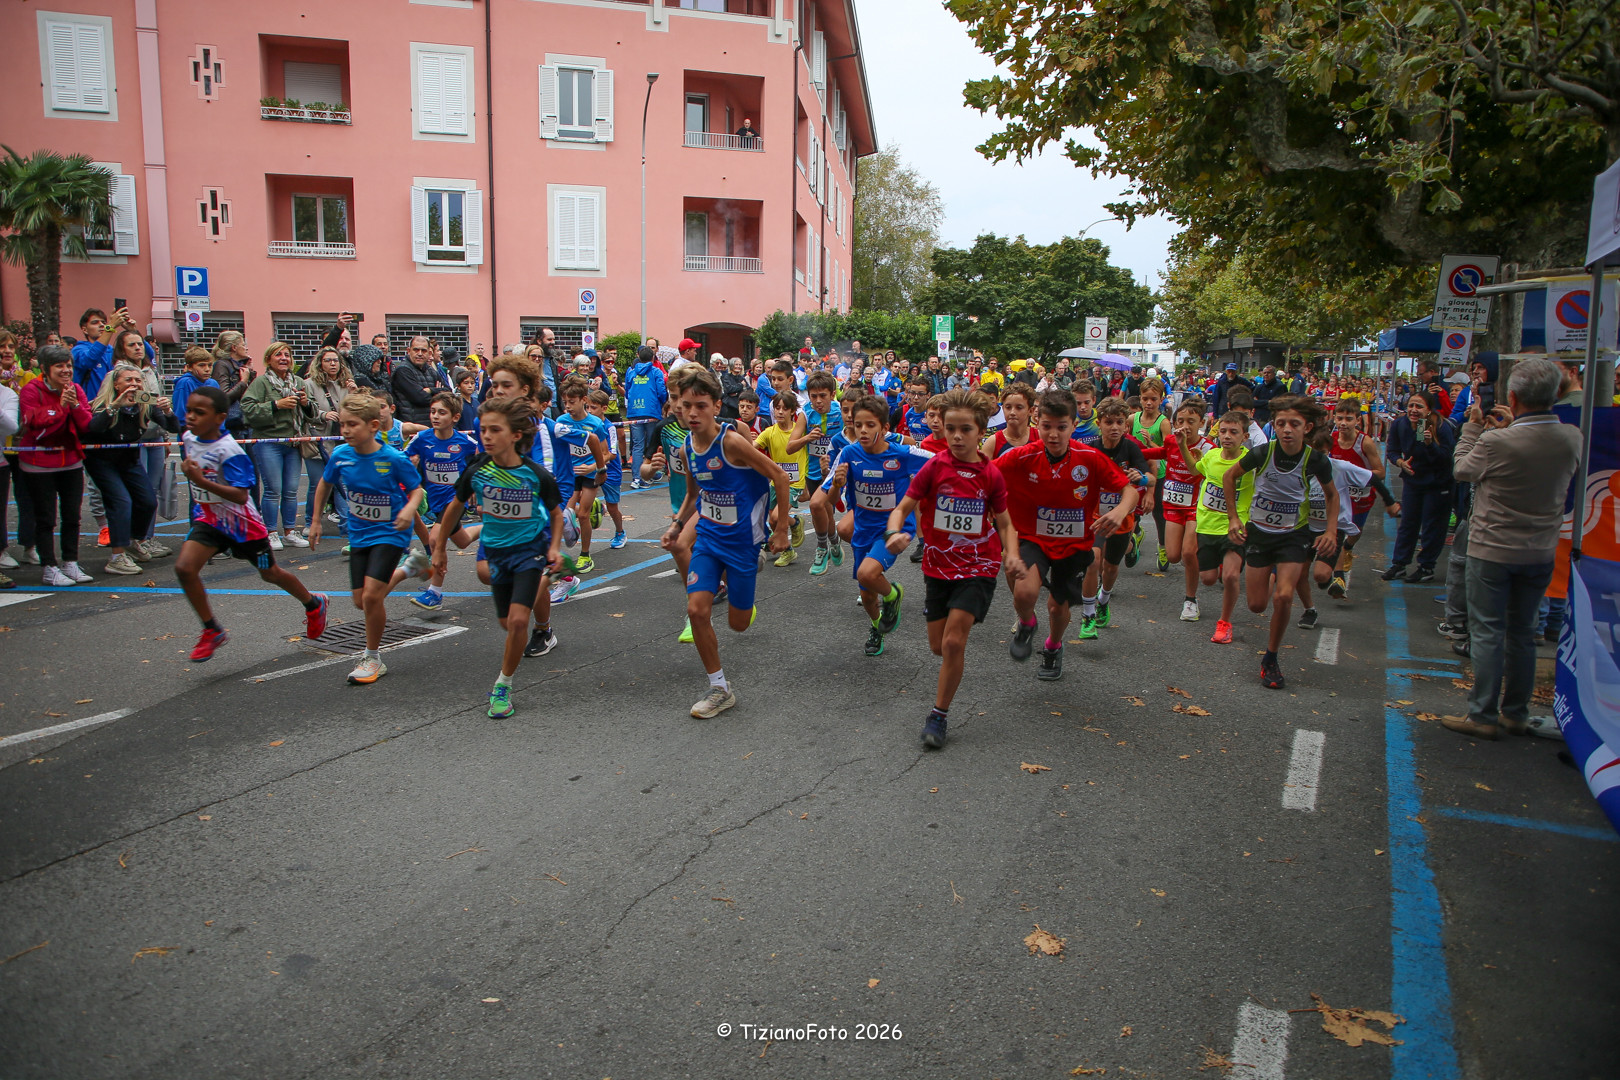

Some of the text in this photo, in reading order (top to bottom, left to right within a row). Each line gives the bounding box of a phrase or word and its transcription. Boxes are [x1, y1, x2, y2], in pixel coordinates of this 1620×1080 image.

[182, 270, 202, 294] P
[815, 446, 826, 455] 23
[435, 474, 449, 482] 16
[866, 496, 882, 508] 22
[1167, 492, 1184, 503] 333
[355, 505, 380, 518] 240
[492, 502, 520, 516] 390
[709, 506, 722, 520] 18
[1308, 510, 1325, 519] 42
[944, 515, 972, 531] 188
[1266, 513, 1283, 525] 62
[1046, 523, 1073, 535] 524
